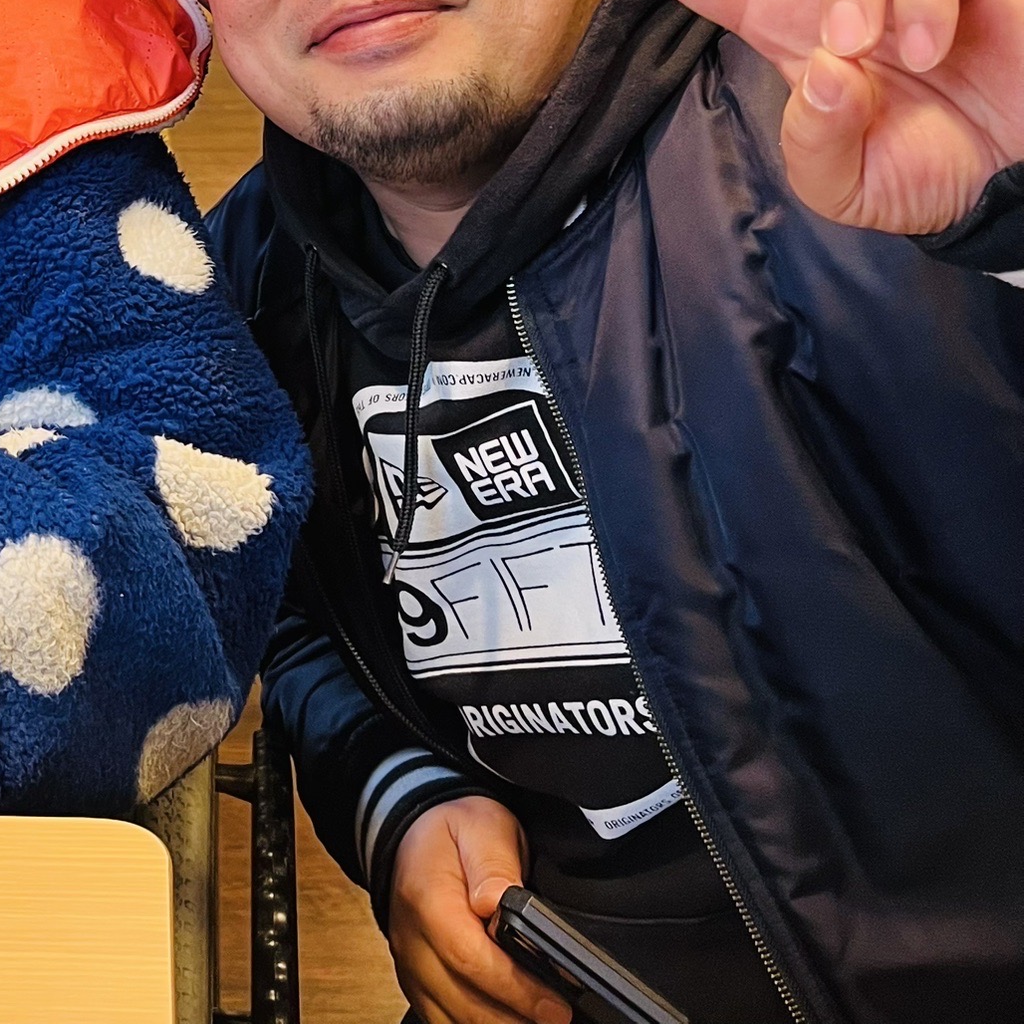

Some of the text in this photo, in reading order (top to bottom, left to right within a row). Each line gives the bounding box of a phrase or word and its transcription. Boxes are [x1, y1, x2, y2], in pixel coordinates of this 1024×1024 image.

[453, 429, 540, 483] NEW
[470, 461, 556, 506] ERA
[458, 696, 658, 737] RIGINATORS
